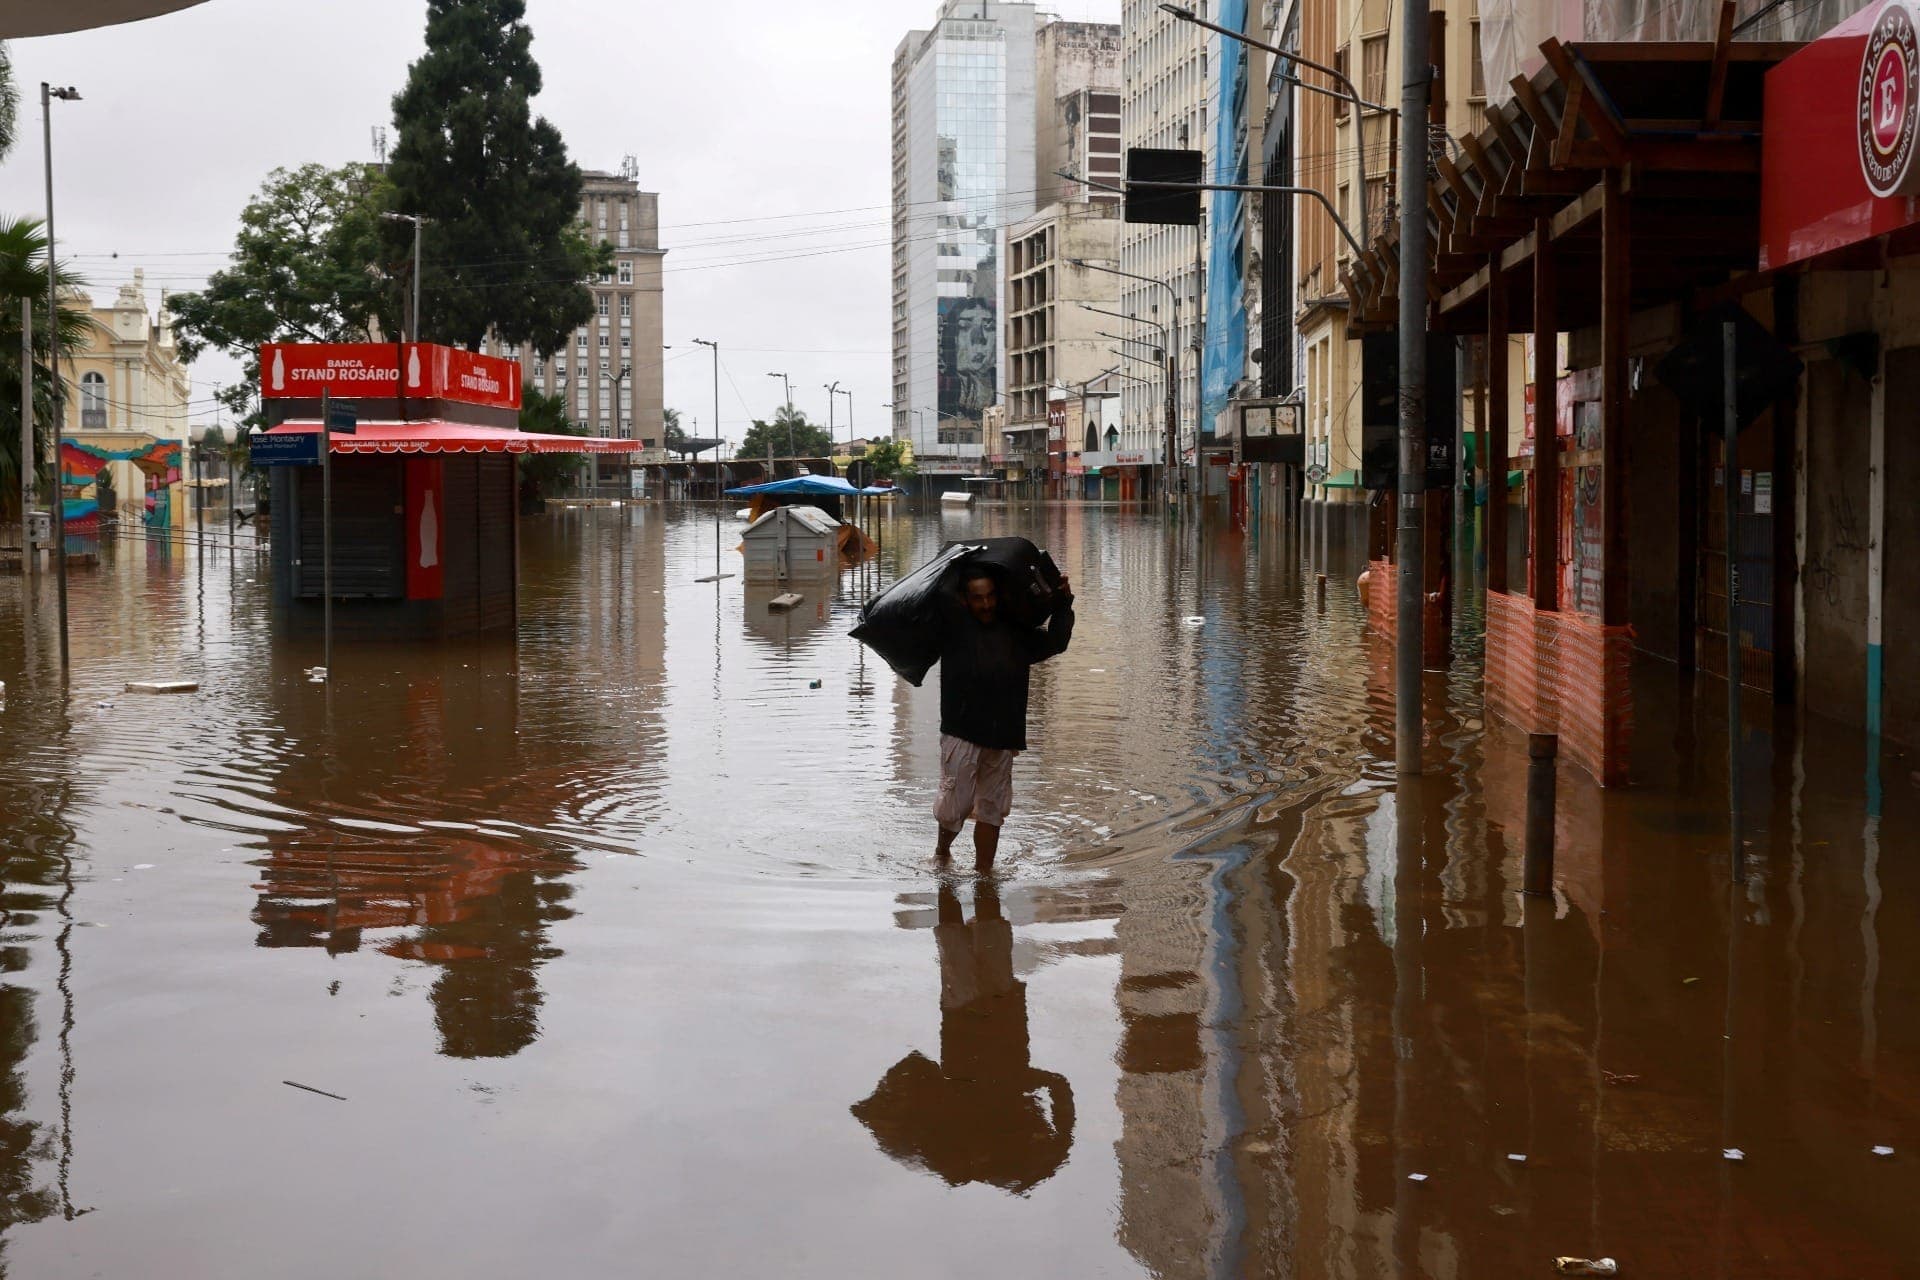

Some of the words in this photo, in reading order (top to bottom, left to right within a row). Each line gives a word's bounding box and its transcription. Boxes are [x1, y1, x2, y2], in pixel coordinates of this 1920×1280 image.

[1862, 16, 1894, 122] BOLSAS
[1896, 16, 1918, 89] LEAL
[1863, 129, 1882, 180] DIRETO
[1882, 164, 1893, 182] DE
[327, 359, 363, 368] BANCA
[291, 368, 336, 381] STAND
[339, 365, 400, 381] ROSÁRIO
[461, 374, 478, 391] STAND
